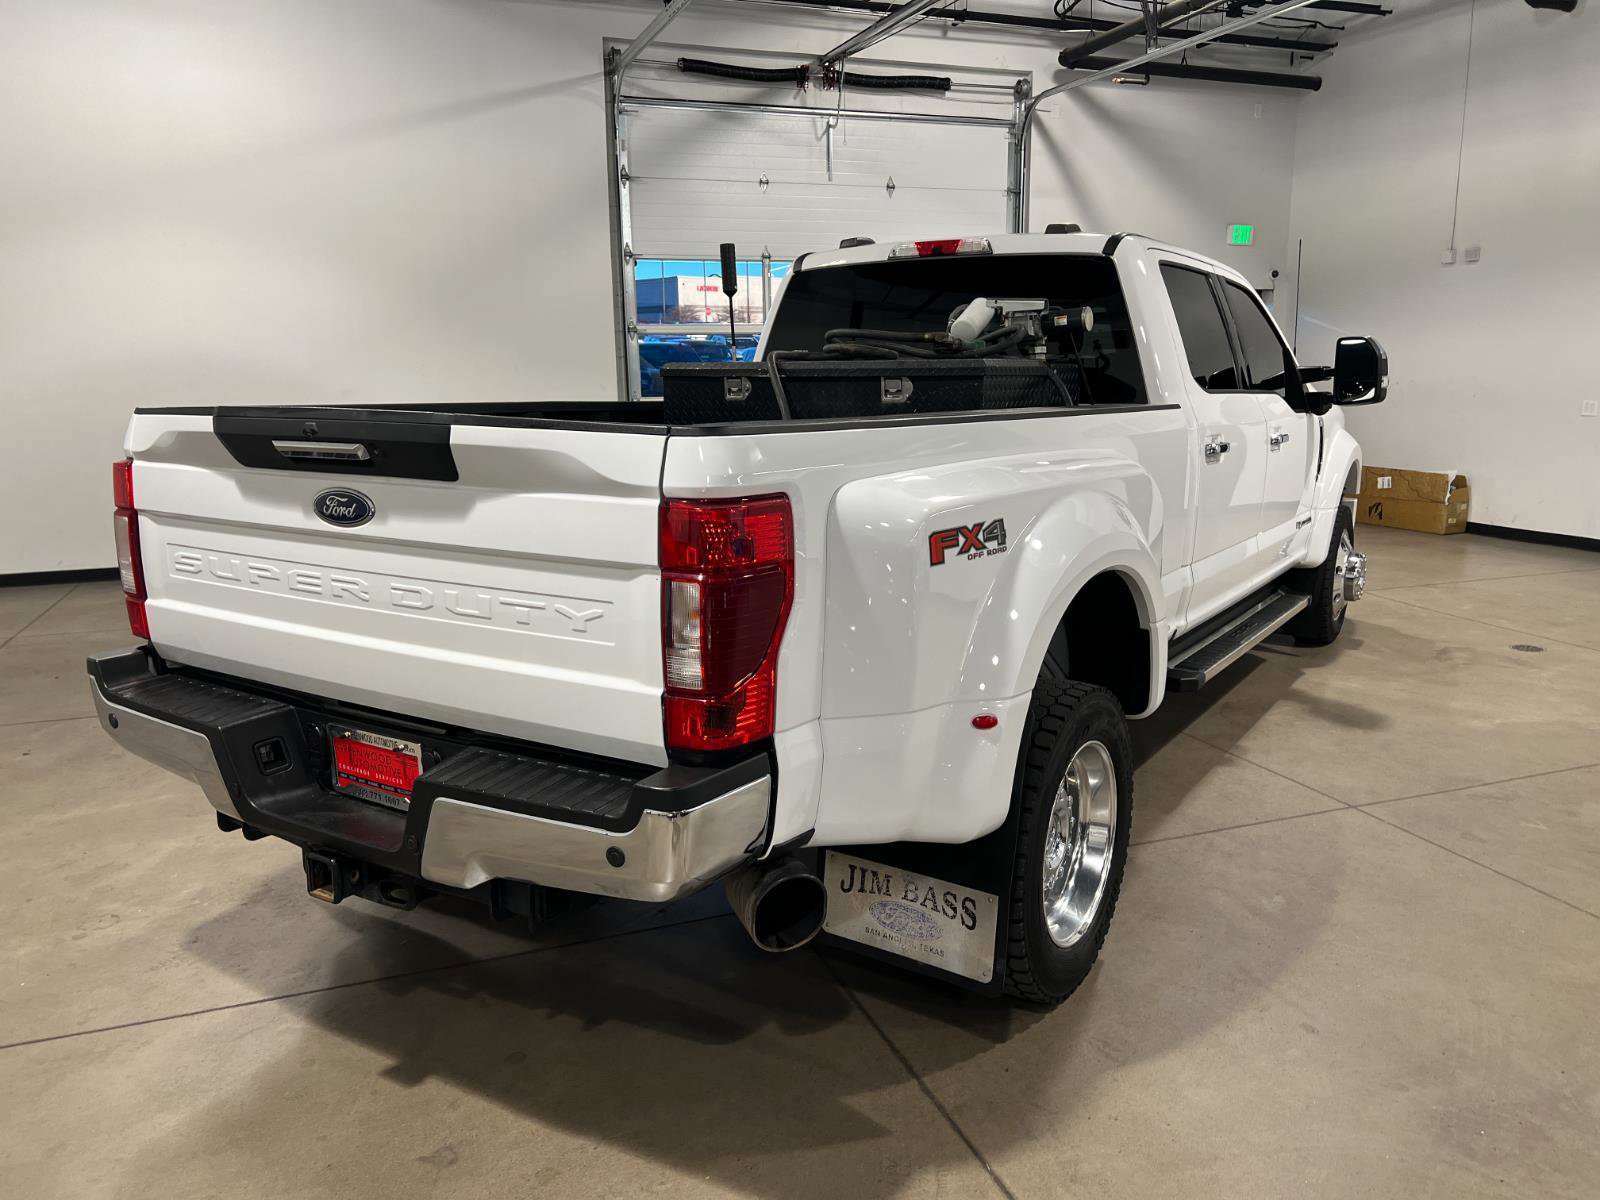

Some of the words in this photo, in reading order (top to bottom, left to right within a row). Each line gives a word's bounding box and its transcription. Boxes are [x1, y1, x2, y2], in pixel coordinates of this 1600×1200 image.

[323, 495, 356, 518] Ford
[928, 517, 1007, 567] FX4
[967, 551, 985, 561] OFF
[986, 545, 1008, 556] ROAD
[174, 551, 370, 602] SUPER
[390, 582, 604, 633] DUTY
[840, 863, 892, 897] JIM
[901, 879, 977, 931] BASS
[864, 926, 881, 937] SAN
